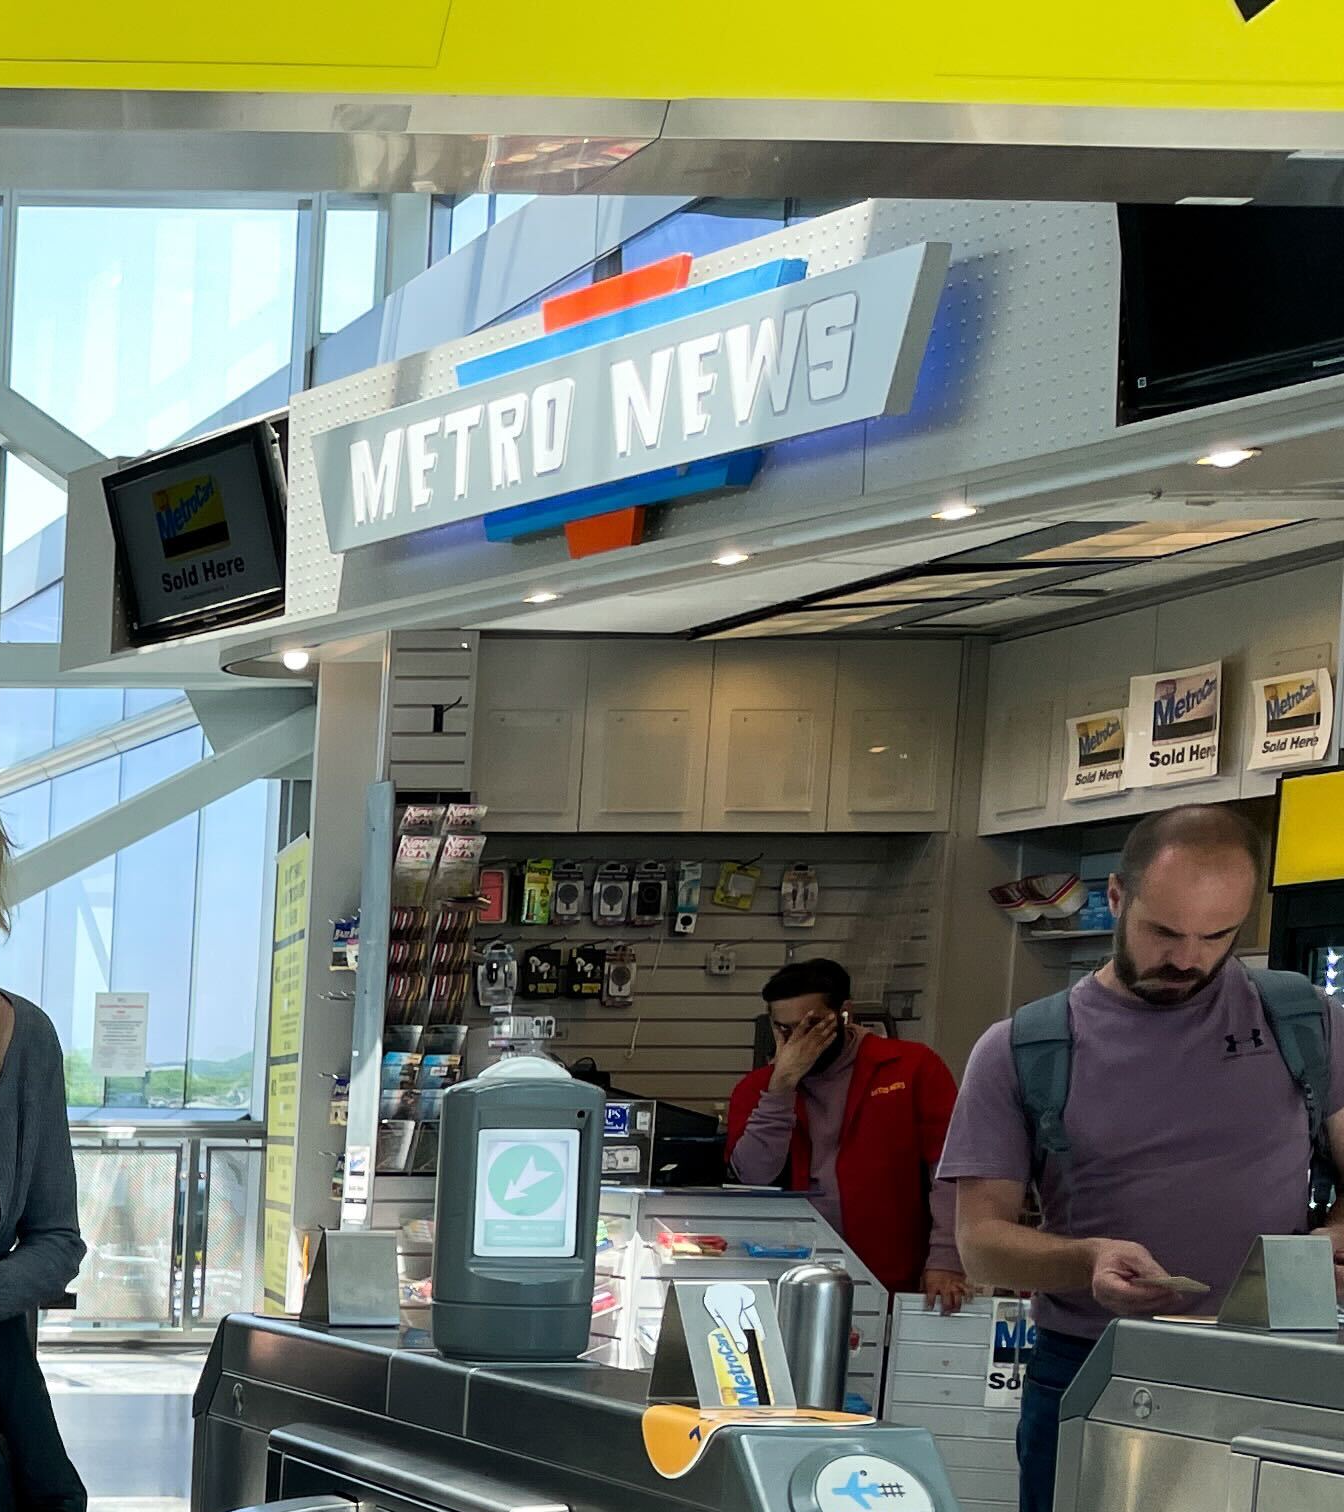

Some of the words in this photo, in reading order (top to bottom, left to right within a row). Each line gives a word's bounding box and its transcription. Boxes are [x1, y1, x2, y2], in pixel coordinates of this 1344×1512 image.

[349, 377, 576, 527] METRO
[610, 290, 859, 459] NEWS
[162, 565, 199, 593] Sold
[202, 556, 245, 580] Here
[1148, 749, 1185, 768] Sold
[1190, 744, 1217, 762] Here
[1262, 738, 1288, 755] Sold
[1291, 734, 1319, 750] Here
[1075, 771, 1096, 786] Sold
[1098, 769, 1123, 784] Here
